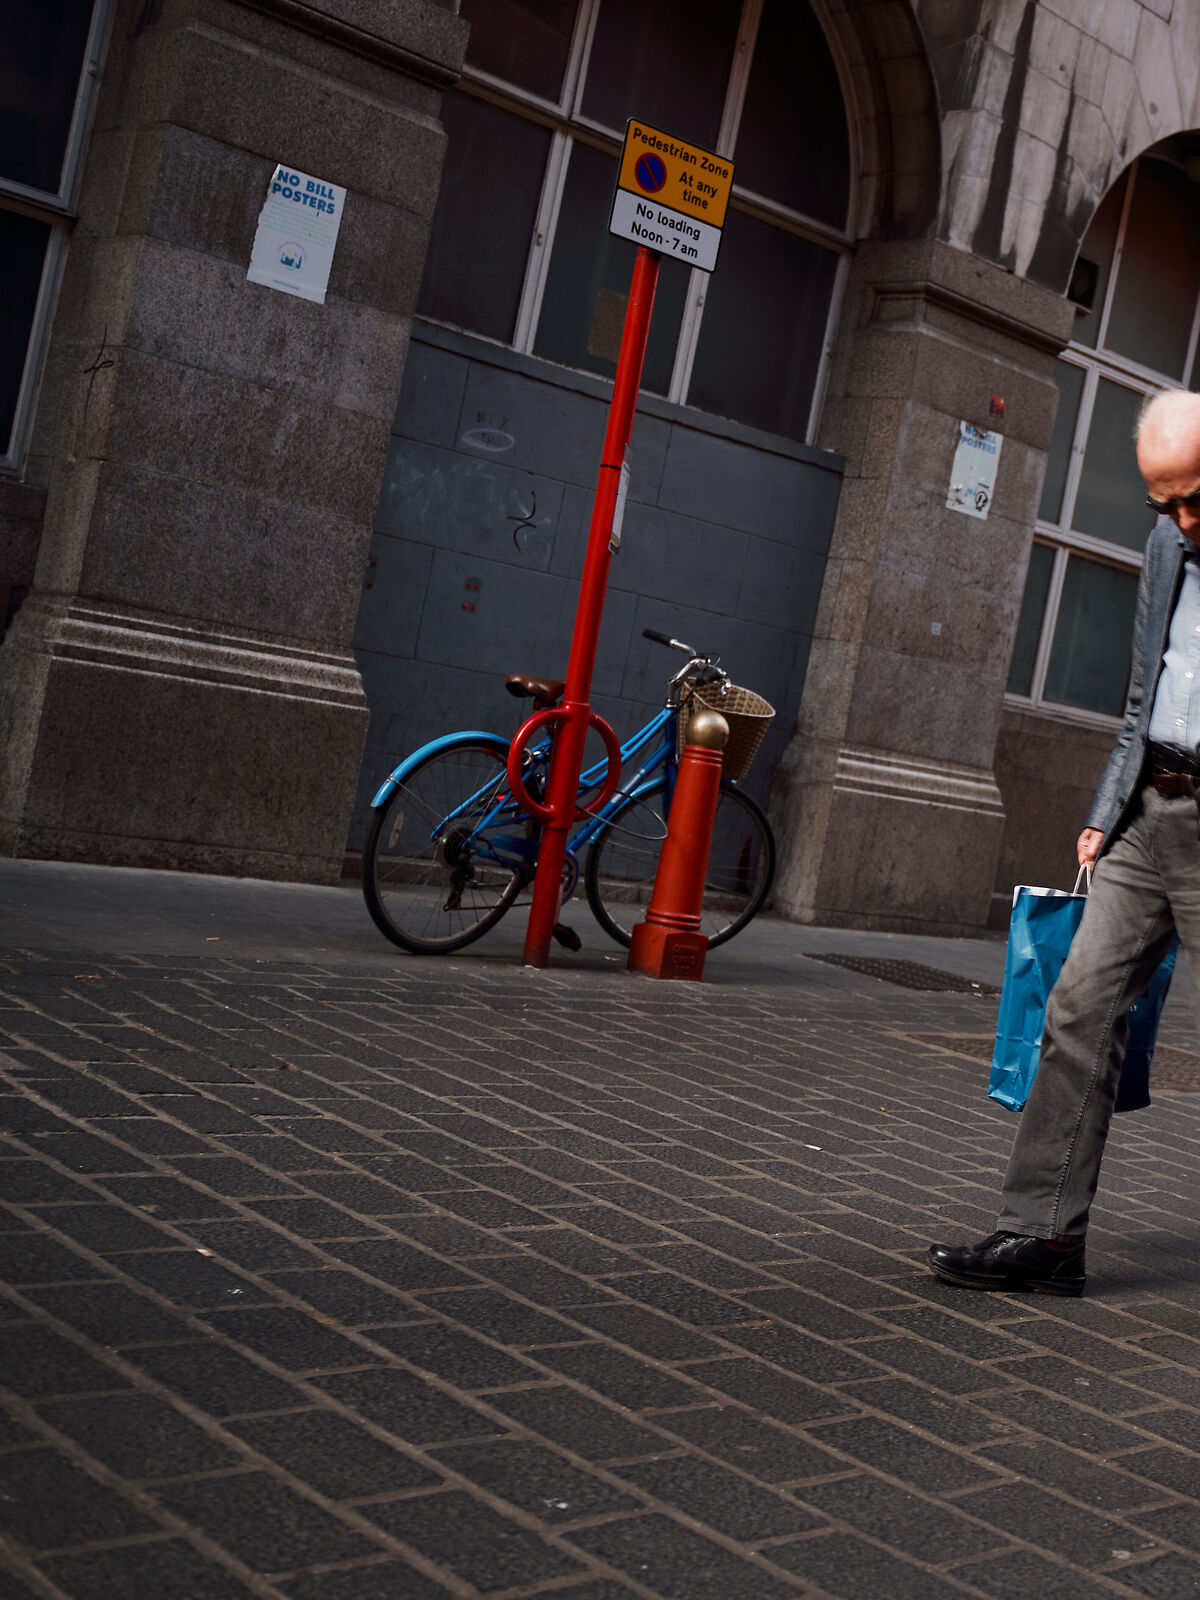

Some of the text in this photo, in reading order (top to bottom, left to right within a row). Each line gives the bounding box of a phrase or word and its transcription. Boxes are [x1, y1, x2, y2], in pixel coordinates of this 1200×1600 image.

[633, 128, 729, 179] Pedestrian Zone
[272, 183, 335, 214] POSTERS
[277, 169, 335, 200] NO BILL
[679, 172, 718, 199] At any
[683, 190, 709, 209] time
[631, 221, 663, 245] Noon
[636, 203, 701, 241] No loading
[961, 436, 997, 455] POSTERS
